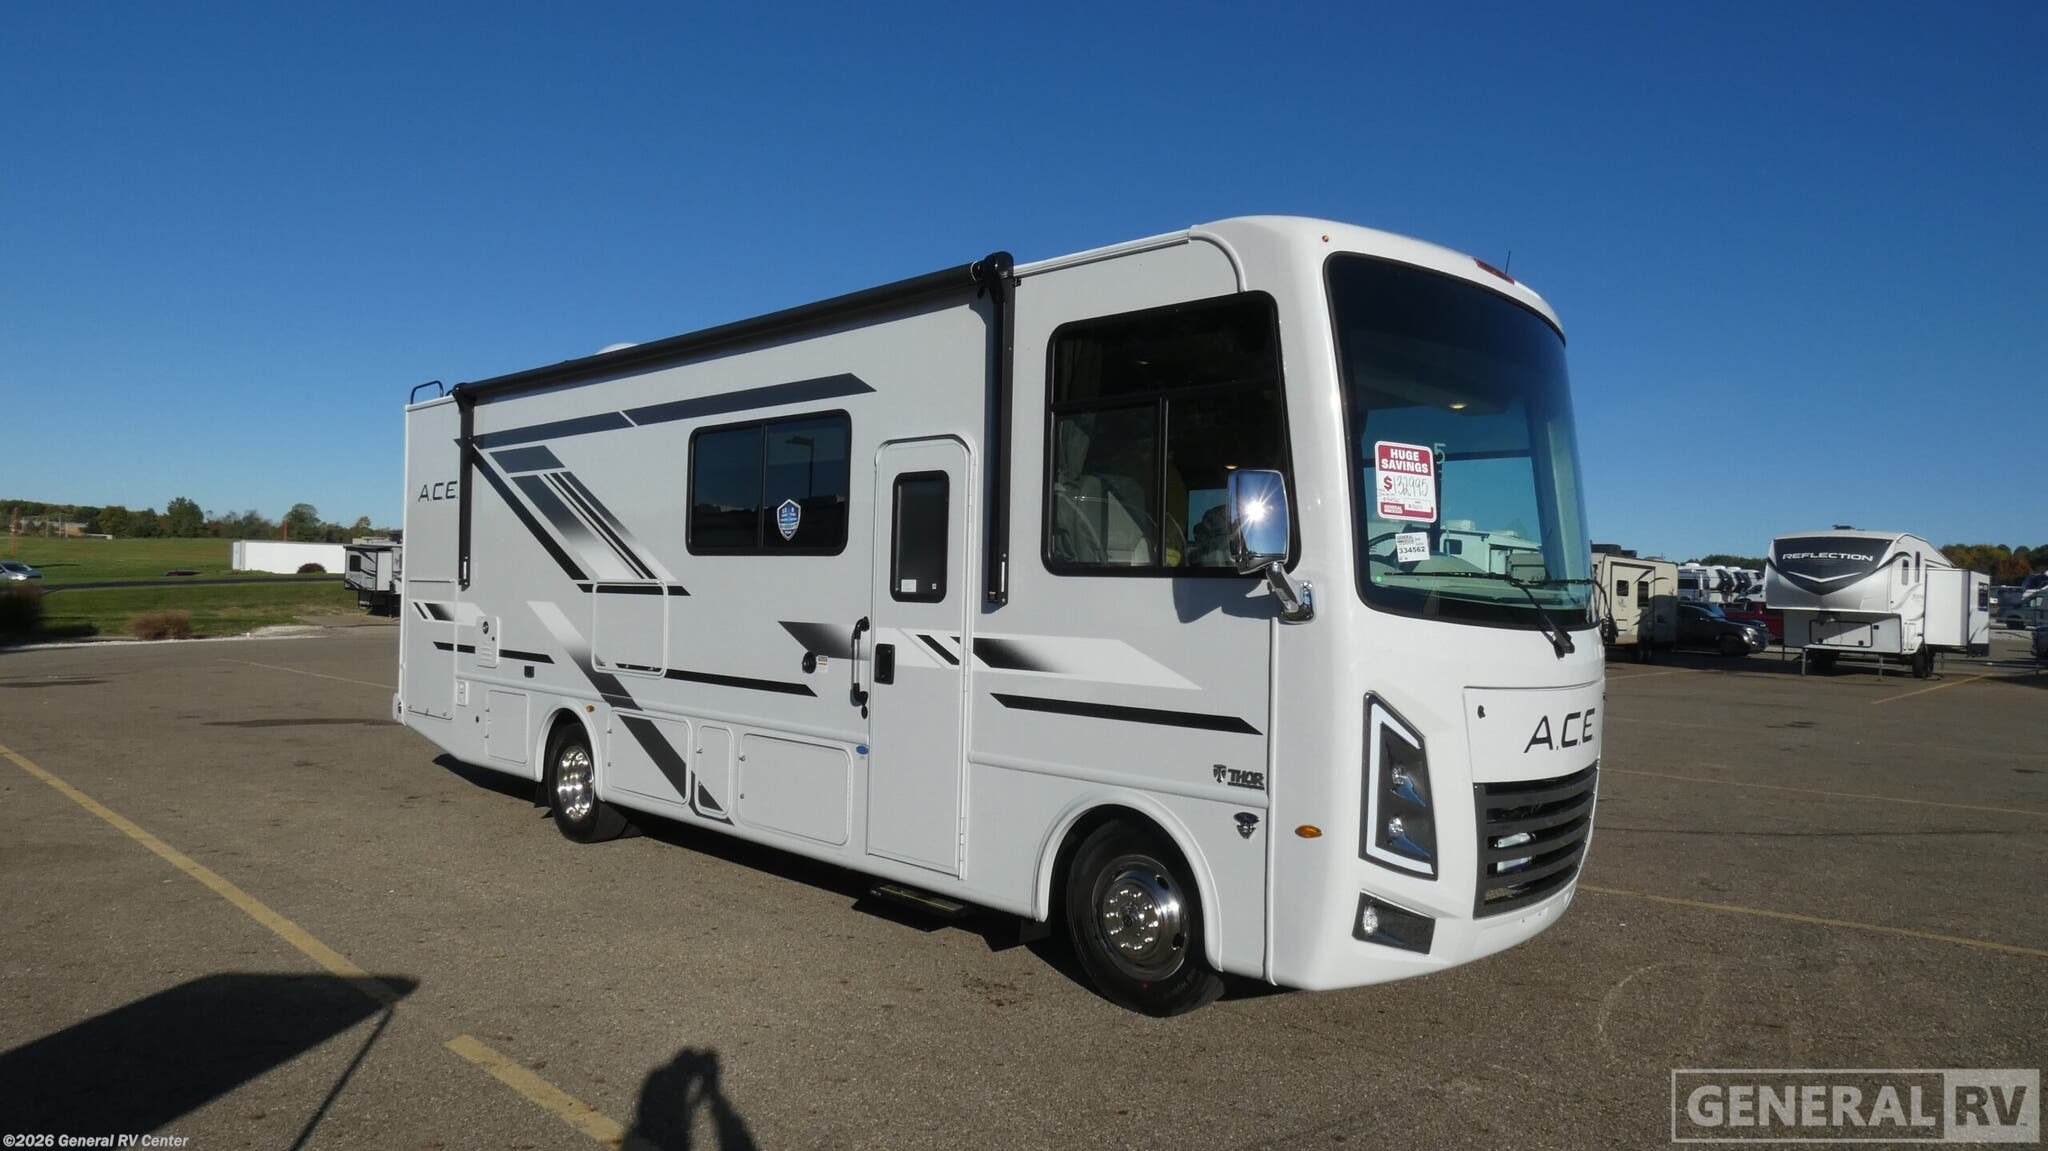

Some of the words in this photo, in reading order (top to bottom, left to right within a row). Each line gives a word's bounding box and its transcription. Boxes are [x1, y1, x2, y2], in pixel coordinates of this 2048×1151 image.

[1390, 448, 1420, 461] HUGE
[1381, 458, 1429, 474] SAVINGS
[1399, 546, 1426, 554] 334562
[1782, 552, 1874, 562] REFLECTION
[1227, 768, 1265, 787] THOR
